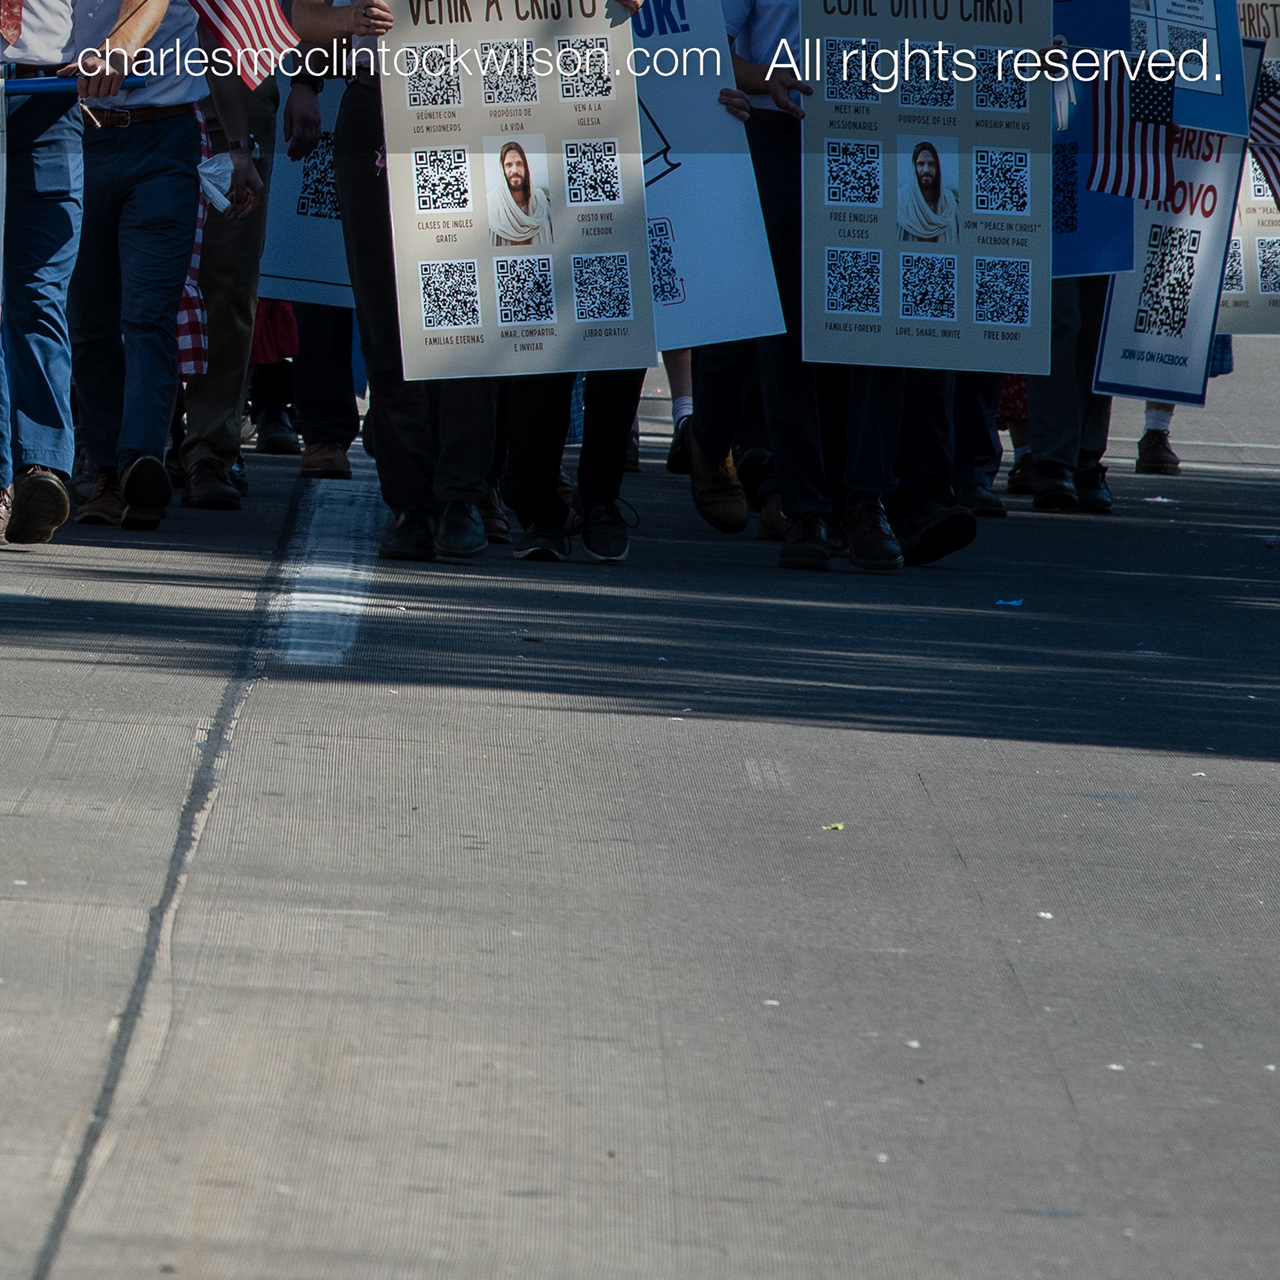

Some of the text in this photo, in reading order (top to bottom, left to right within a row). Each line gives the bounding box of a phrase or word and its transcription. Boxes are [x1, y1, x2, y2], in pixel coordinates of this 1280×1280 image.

[1171, 1, 1200, 11] Meet with
[1166, 8, 1204, 21] Missionaries!
[490, 107, 532, 118] PROPÓSITO DE
[574, 103, 602, 113] VEN A LA
[834, 105, 870, 115] MEET WITH
[416, 110, 456, 120] REÚNETE CON
[898, 115, 957, 126] PURPOSE OF LIFE
[501, 122, 524, 132] LA VIDA
[577, 118, 601, 127] IGLESIA
[829, 120, 878, 131] MISSIONARIES
[975, 120, 1030, 130] WORSHIP WITH US
[413, 124, 461, 134] LOS MISIONEROS
[577, 212, 613, 223] CRISTO VIVE
[830, 212, 878, 223] FREE ENGLISH
[418, 219, 473, 230] CLASES DE INGLES
[964, 221, 978, 229] JOIN
[1006, 223, 1014, 231] IN
[581, 227, 613, 237] FACEBOOK
[838, 229, 869, 239] CLASSES
[436, 234, 457, 243] GRATIS
[978, 236, 1028, 247] FACEBOOK PAGE
[500, 327, 557, 339] AMAR, COMPARTIR,
[825, 322, 881, 333] FAMILIES FOREVER
[896, 327, 961, 339] LOVE, SHARE, INVITE
[583, 327, 629, 341] ¡LIBRO GRATIS!
[984, 330, 1020, 341] FREE BOOK!
[424, 334, 484, 346] FAMILIAS ETERNAS
[514, 342, 543, 351] E INVITAR
[1121, 348, 1189, 367] JOIN US ON FACEBOOK
